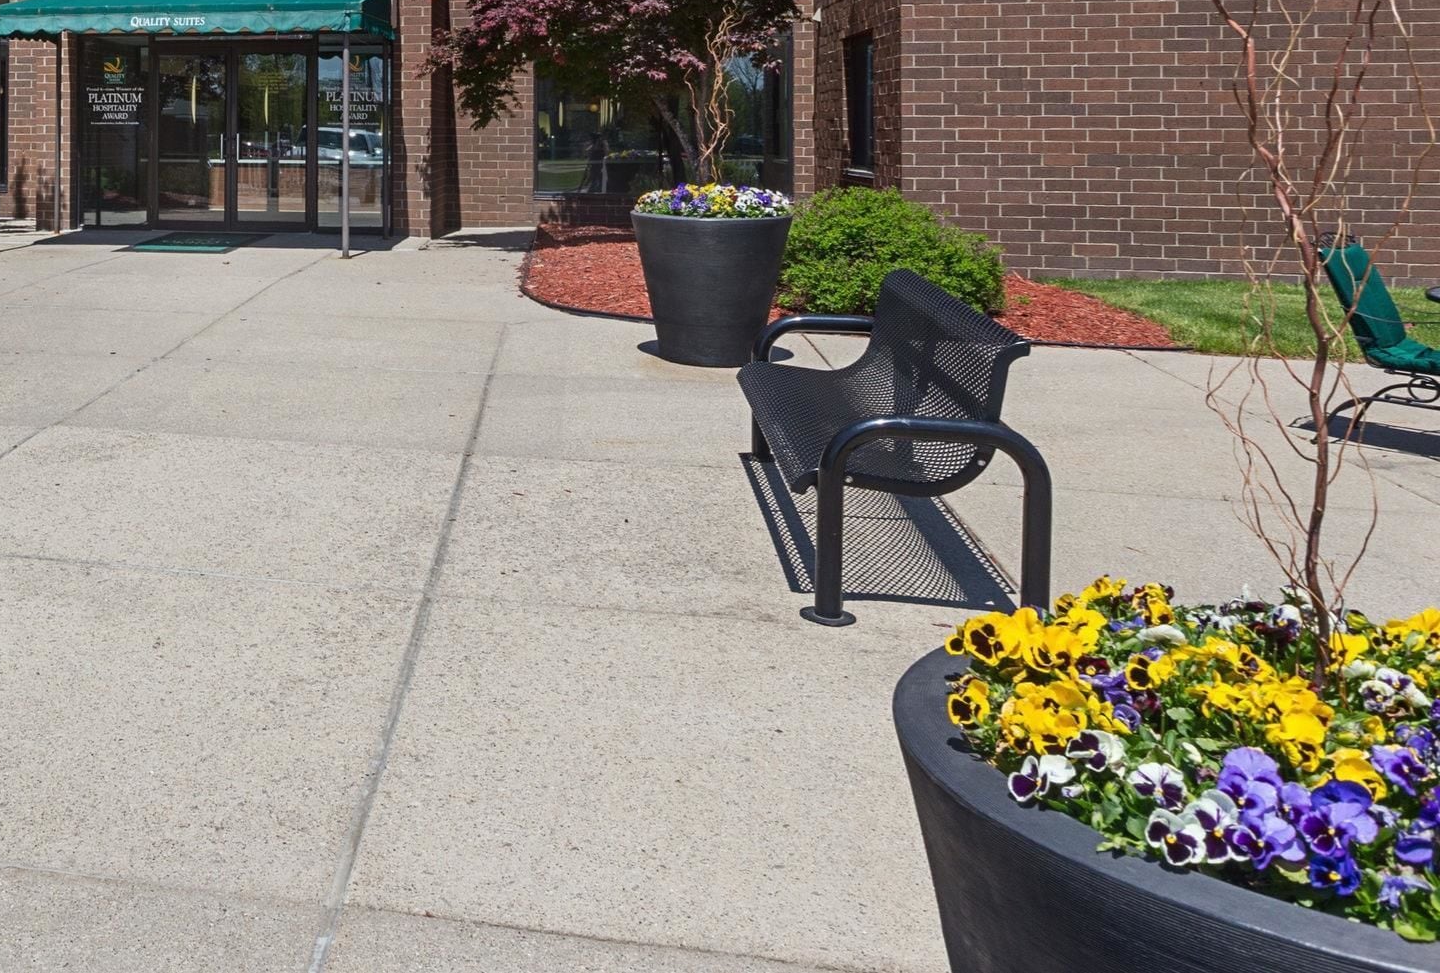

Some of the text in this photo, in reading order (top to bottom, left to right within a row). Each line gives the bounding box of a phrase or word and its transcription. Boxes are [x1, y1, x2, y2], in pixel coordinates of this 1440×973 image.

[130, 16, 206, 27] QUALITY SUITES
[88, 93, 142, 104] PLATINUM
[326, 91, 384, 103] PLINUM
[92, 104, 138, 112] HOSPITALITY
[329, 104, 378, 112] HOITALITY
